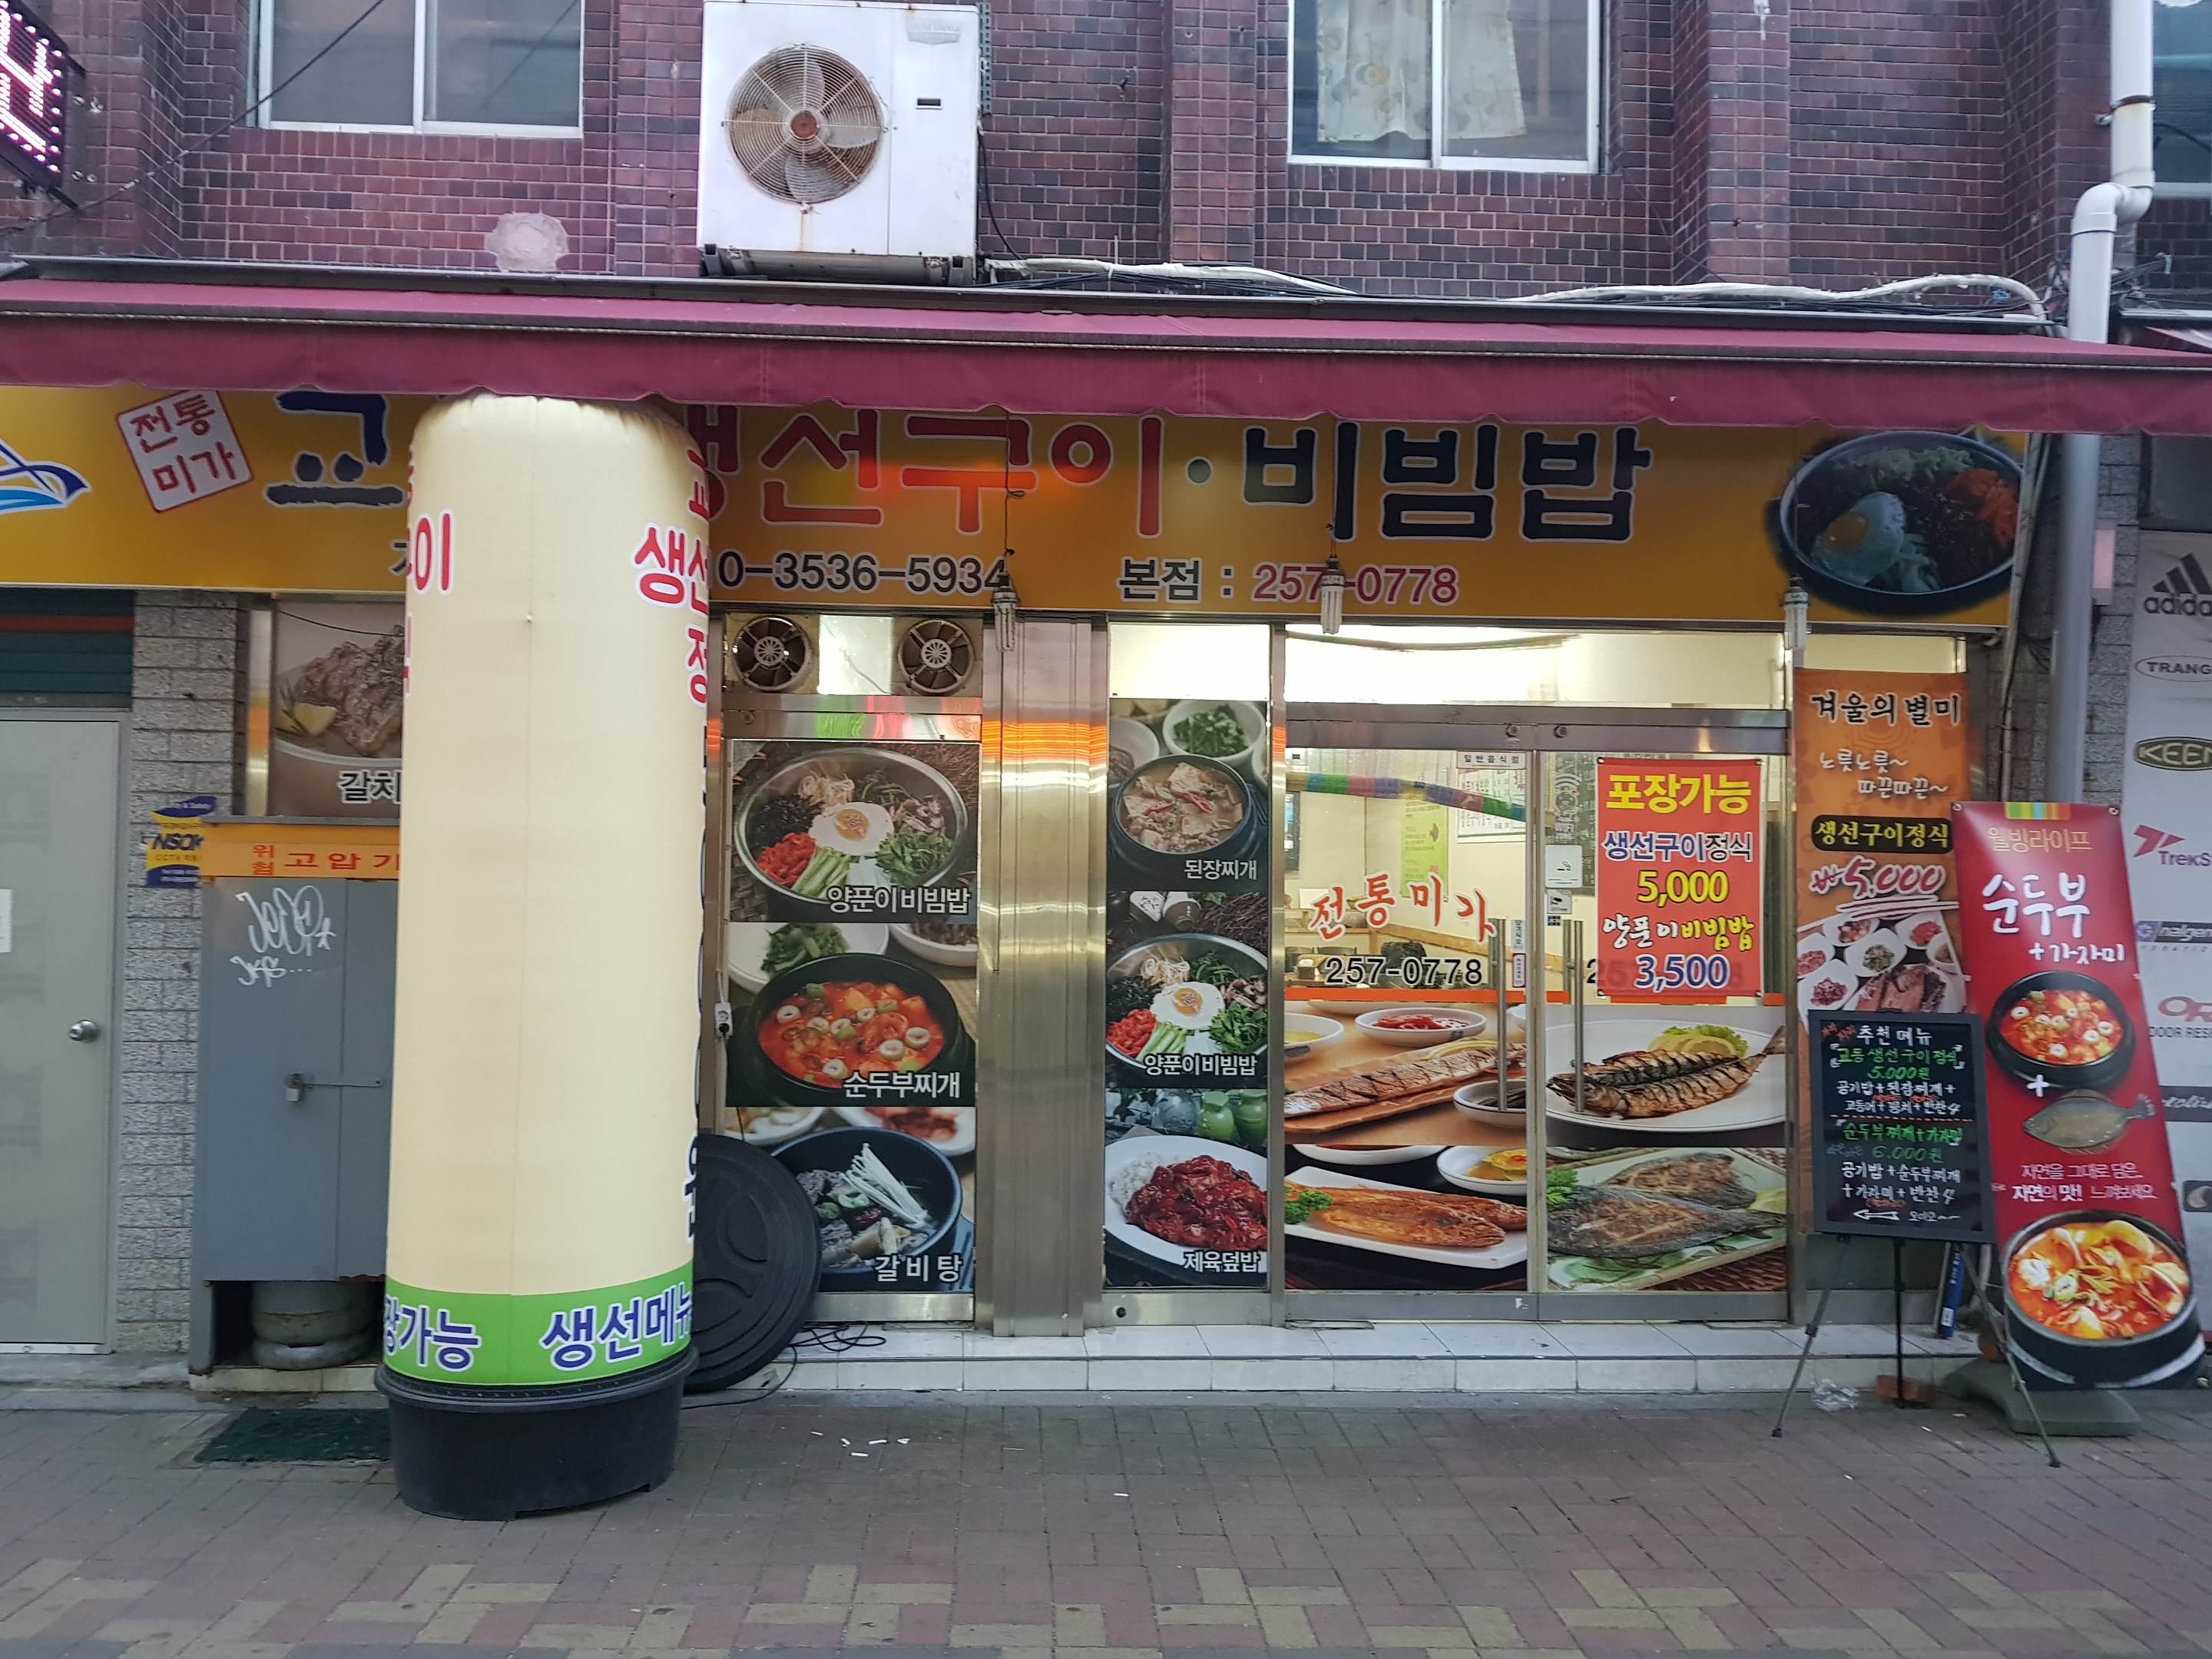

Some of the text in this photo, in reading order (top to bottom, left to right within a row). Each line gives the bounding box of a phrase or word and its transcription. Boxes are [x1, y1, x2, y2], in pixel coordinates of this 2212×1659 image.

[1120, 559, 1200, 601] 본점
[1812, 690, 1960, 727] 겨울의 별미
[1606, 773, 1752, 814] 포장가능
[1603, 832, 1753, 862] 생선구이정식
[1815, 820, 1949, 848] 생선구이정식
[1184, 858, 1257, 881] 된장찌개
[1637, 870, 1729, 908] 5,000
[1982, 872, 2091, 939] 순두부
[1325, 958, 1482, 985] 257-0778
[1634, 955, 1730, 992] 3,500
[843, 1072, 961, 1098] 순두부찌개
[2012, 1184, 2058, 1201] 자연의
[1183, 1250, 1260, 1273] 제육덮밥
